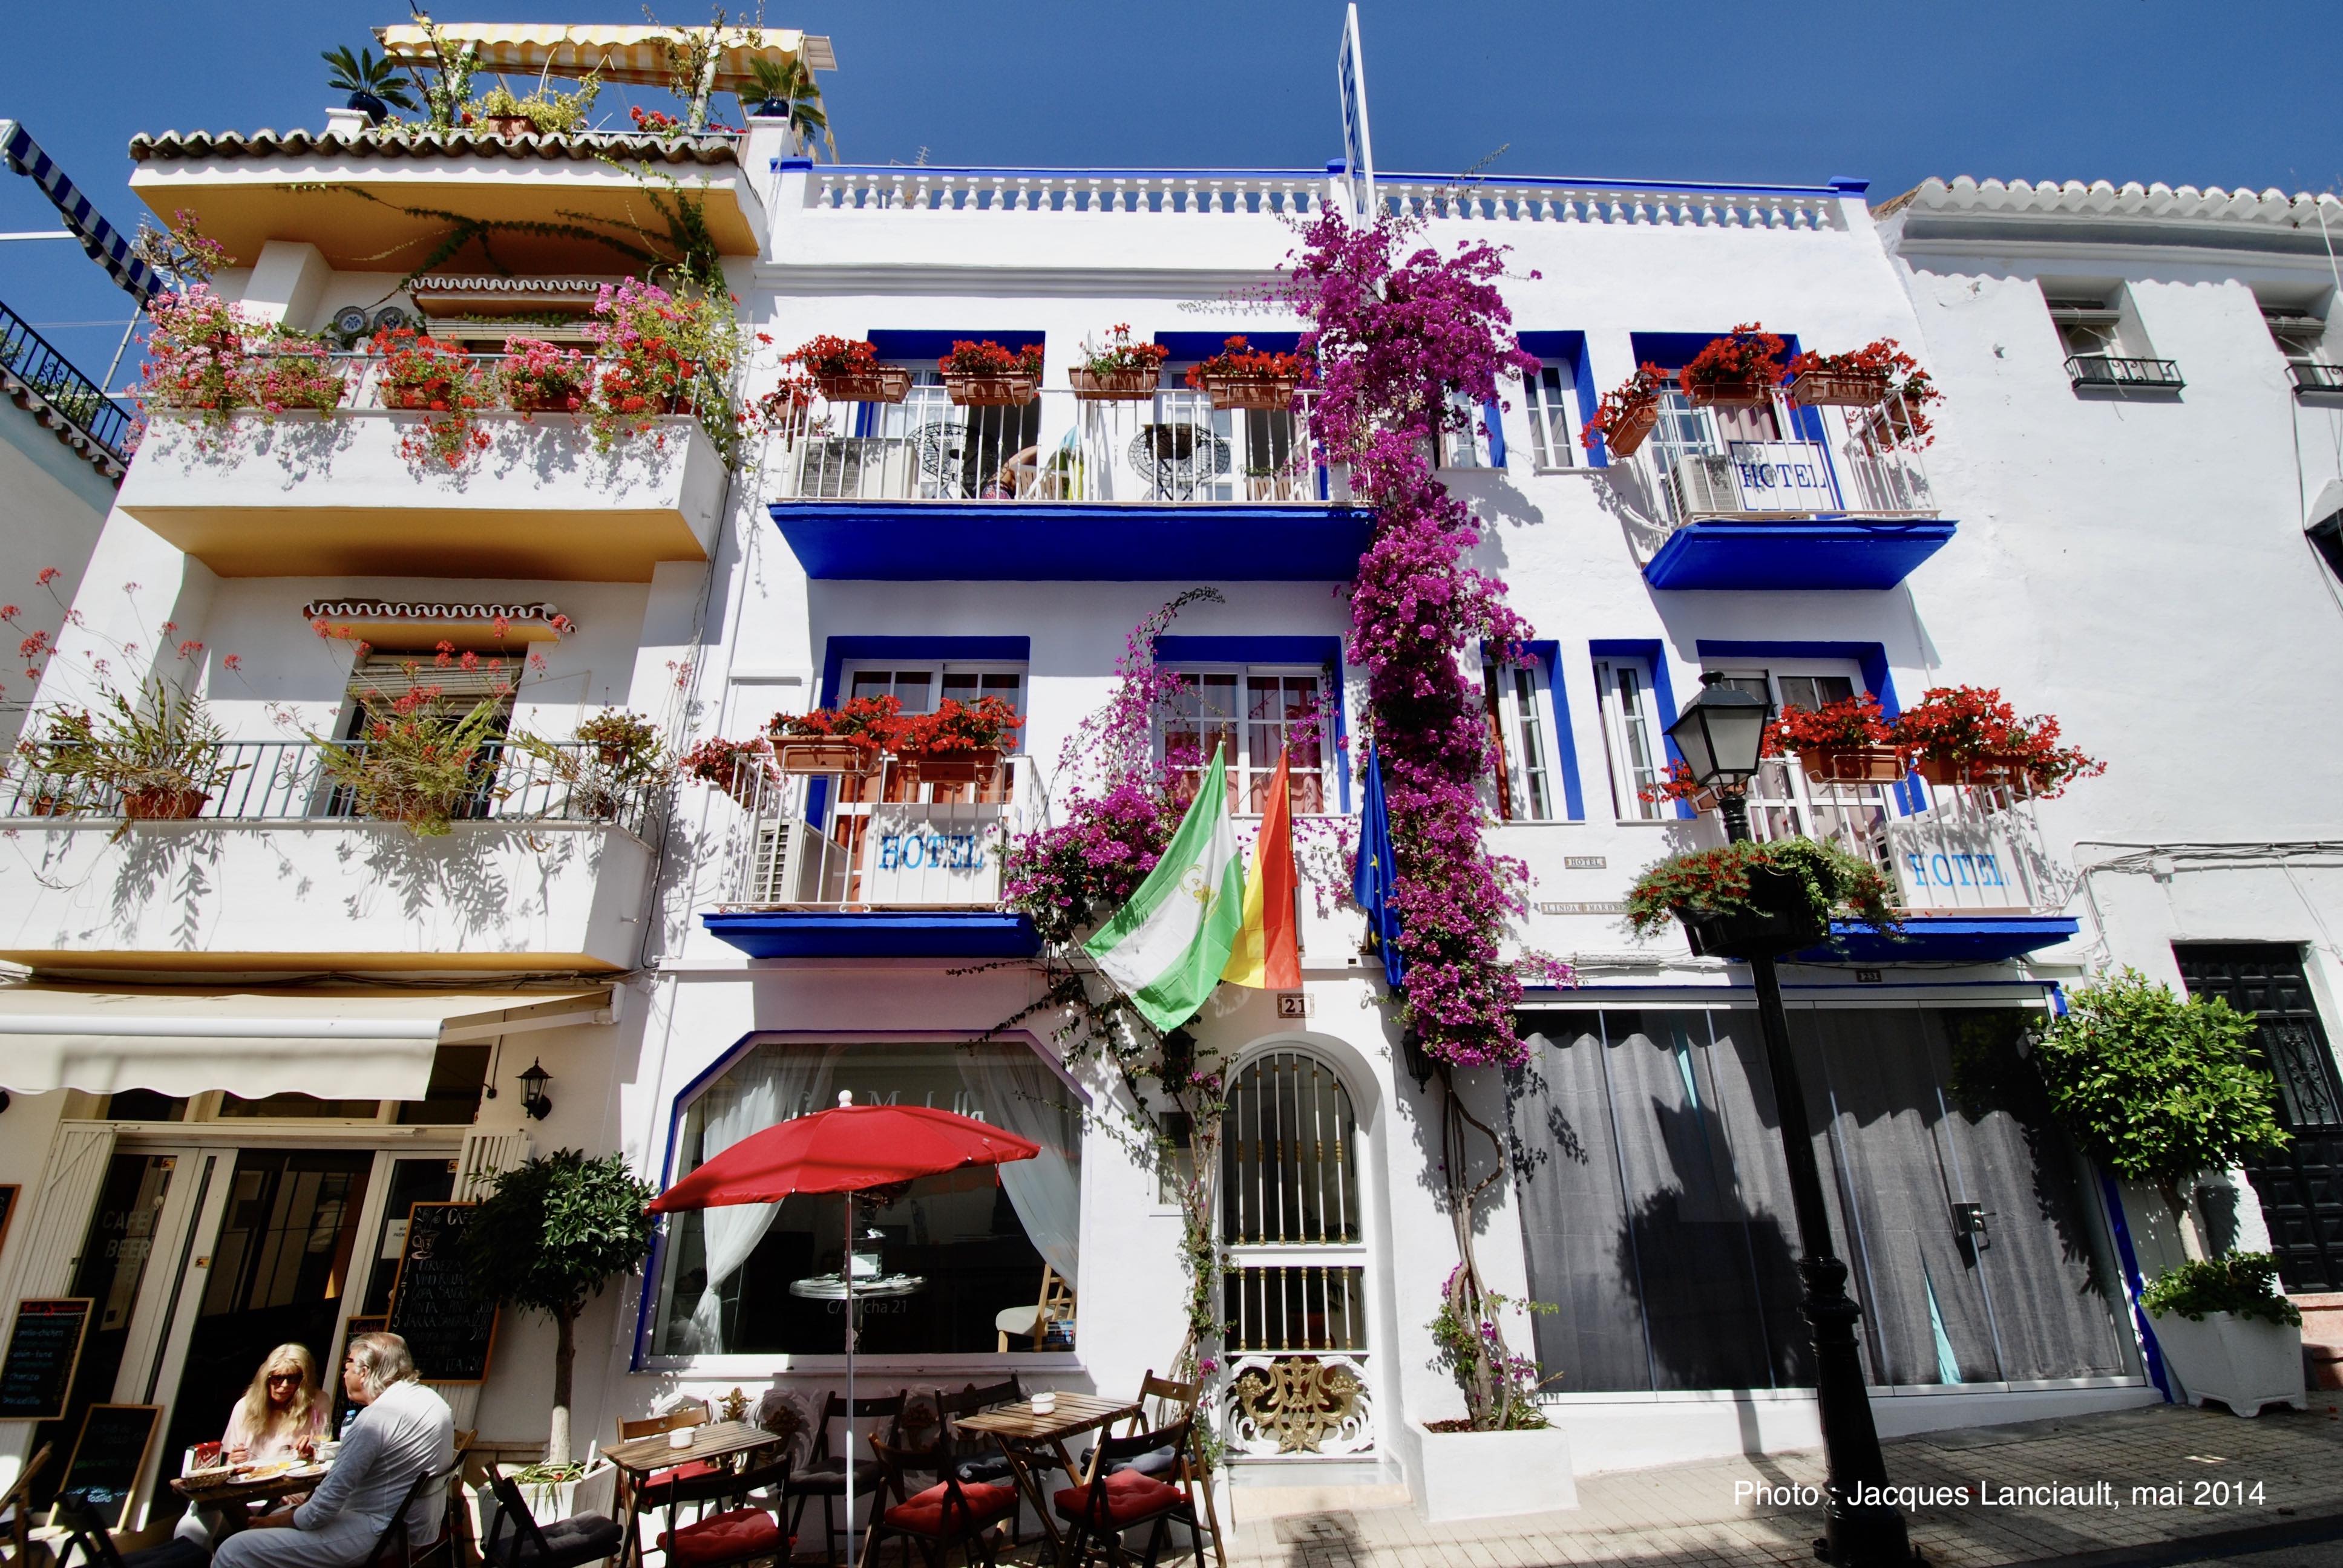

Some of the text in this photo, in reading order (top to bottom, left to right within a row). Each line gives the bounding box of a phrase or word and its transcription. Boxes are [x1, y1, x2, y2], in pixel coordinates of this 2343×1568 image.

[1739, 463, 1827, 488] HOTEL
[878, 835, 984, 869] HOTEL
[1908, 854, 2010, 887] HOTEL
[1285, 998, 1306, 1013] 21
[102, 1210, 149, 1230] CAFE
[104, 1238, 152, 1259] BEER
[891, 1299, 907, 1313] 21
